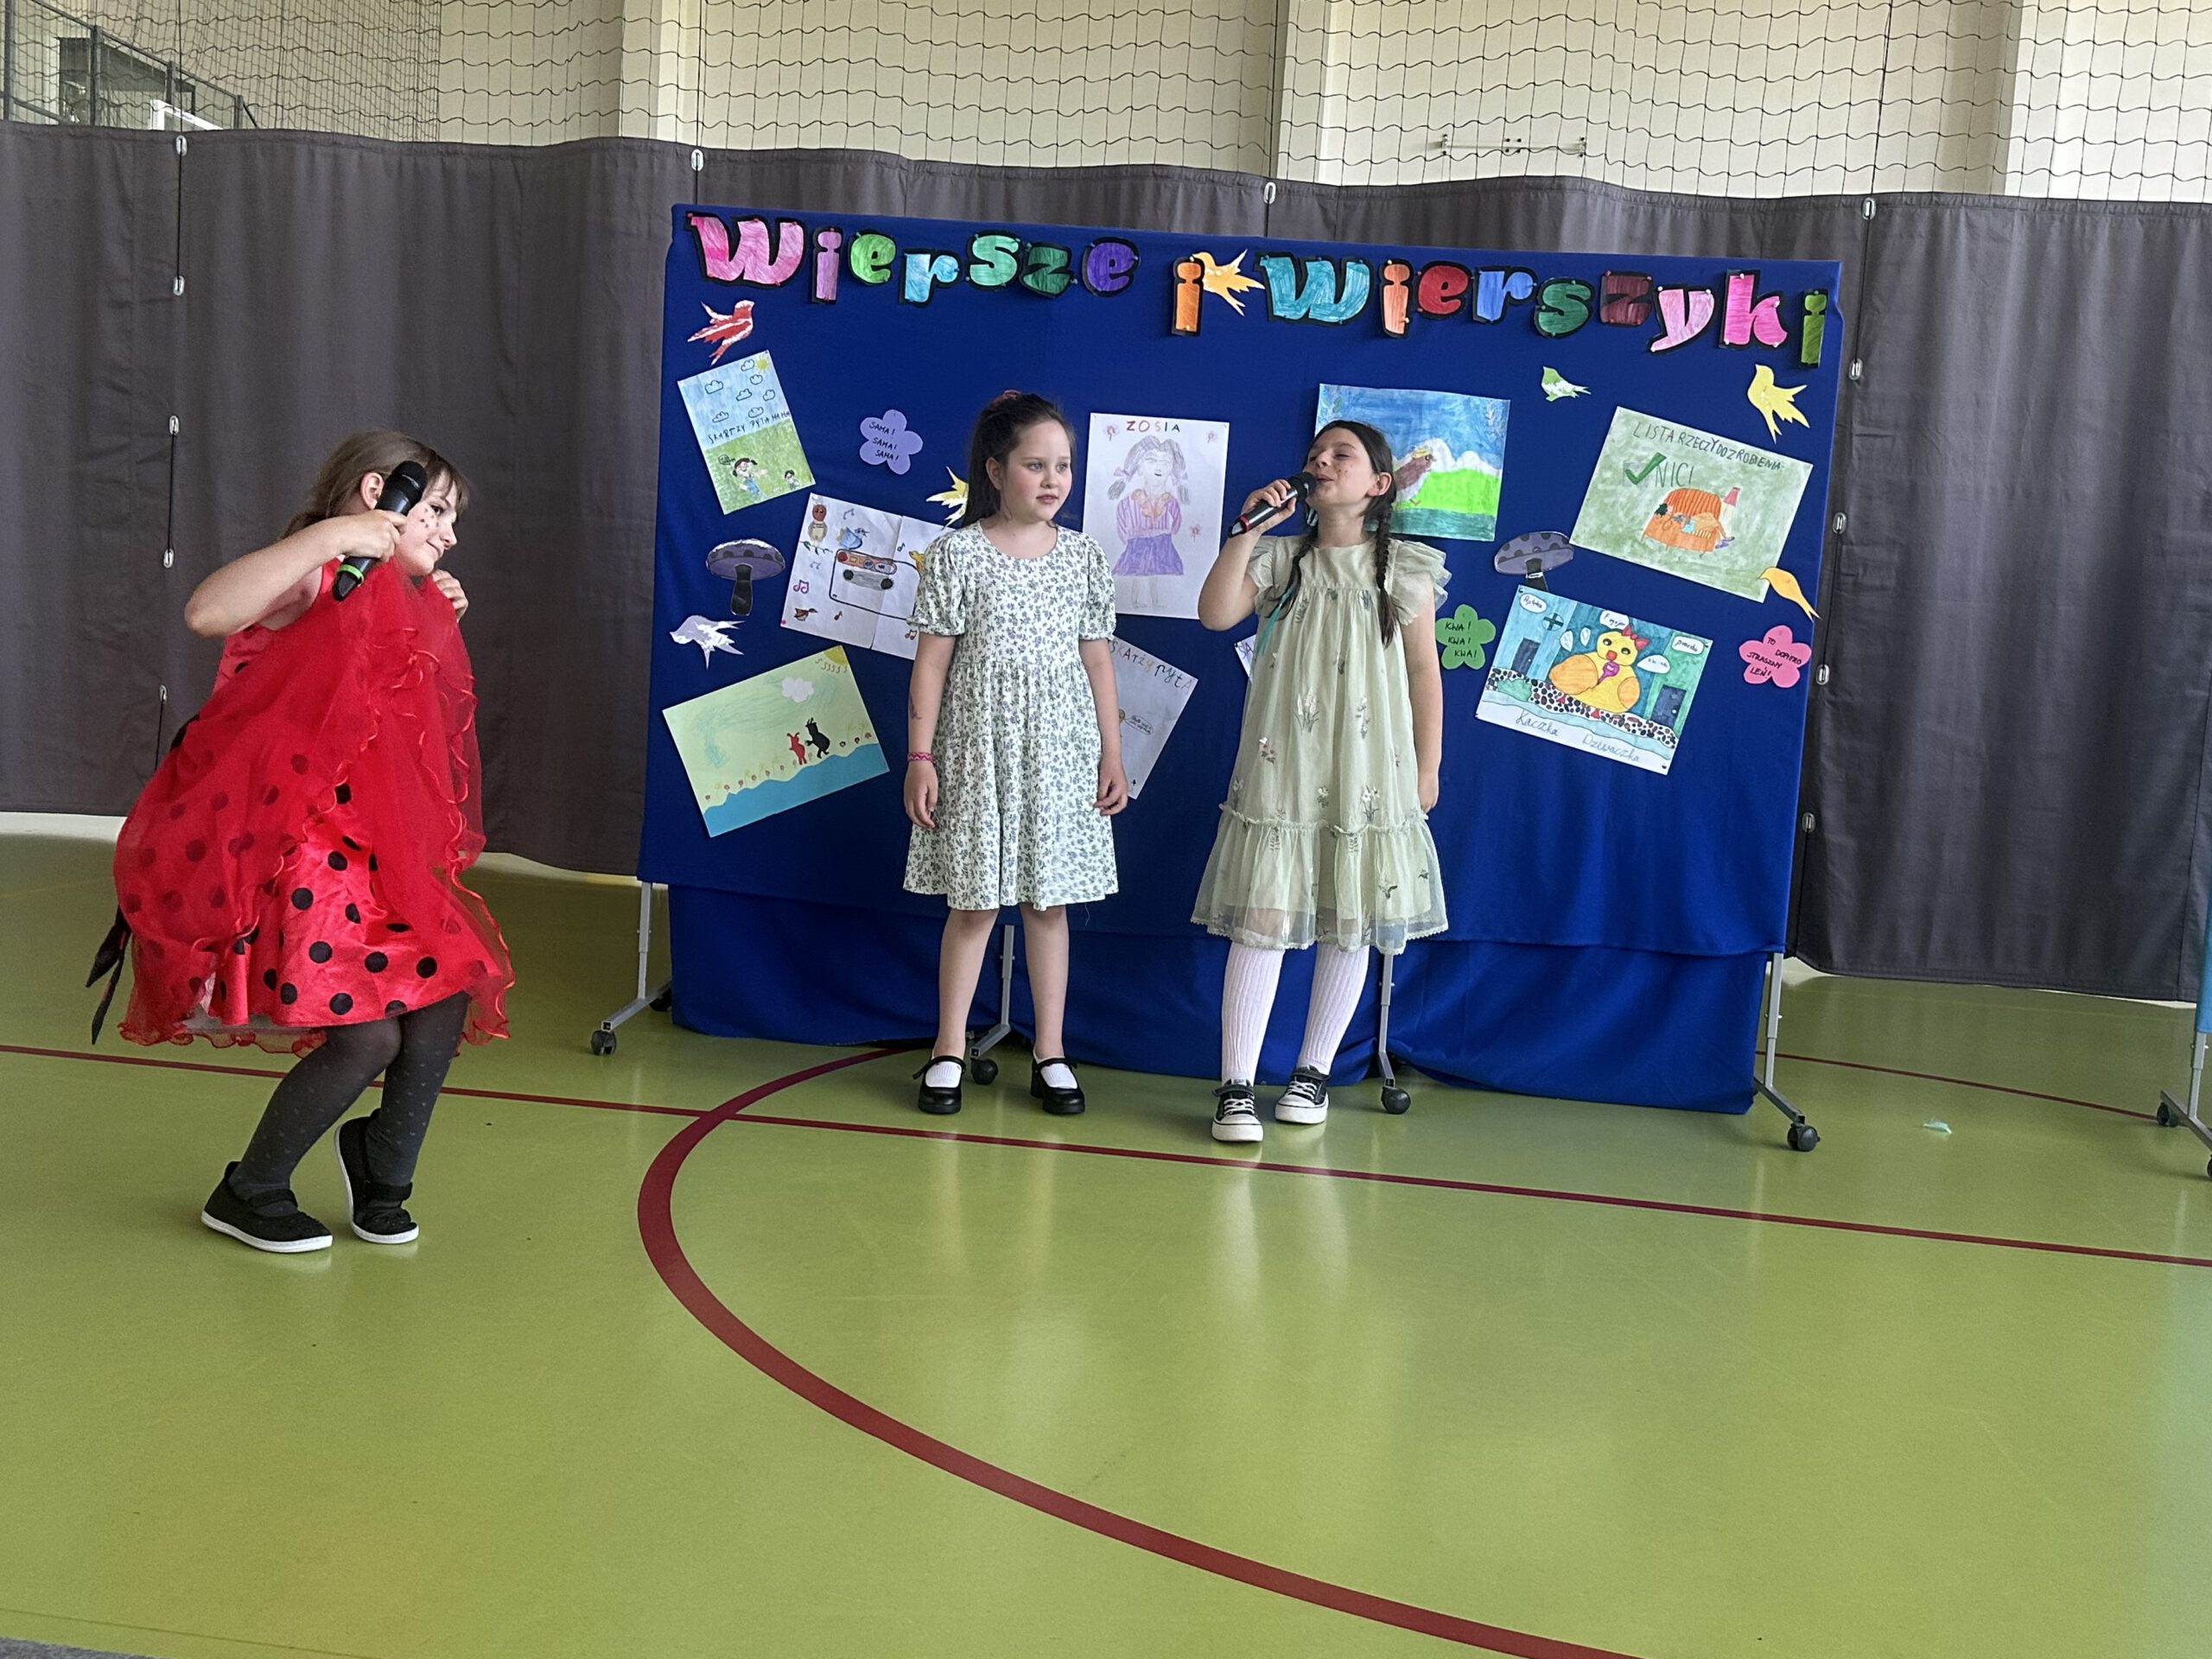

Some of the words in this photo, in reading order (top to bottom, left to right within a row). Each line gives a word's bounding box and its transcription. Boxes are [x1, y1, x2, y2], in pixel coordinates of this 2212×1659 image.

[688, 213, 1138, 304] Wiersze
[1173, 258, 1203, 334] i
[1126, 420, 1180, 432] ZOSIA
[1633, 422, 1675, 442] LISTA
[1445, 620, 1471, 632] KWA!
[1447, 636, 1471, 647] KWA!
[1767, 637, 1776, 645] TO
[1453, 650, 1477, 661] KWA!
[1746, 652, 1783, 669] STRASZNY
[1516, 709, 1558, 735] Kaczka
[1582, 734, 1639, 762] Dziwaczka
